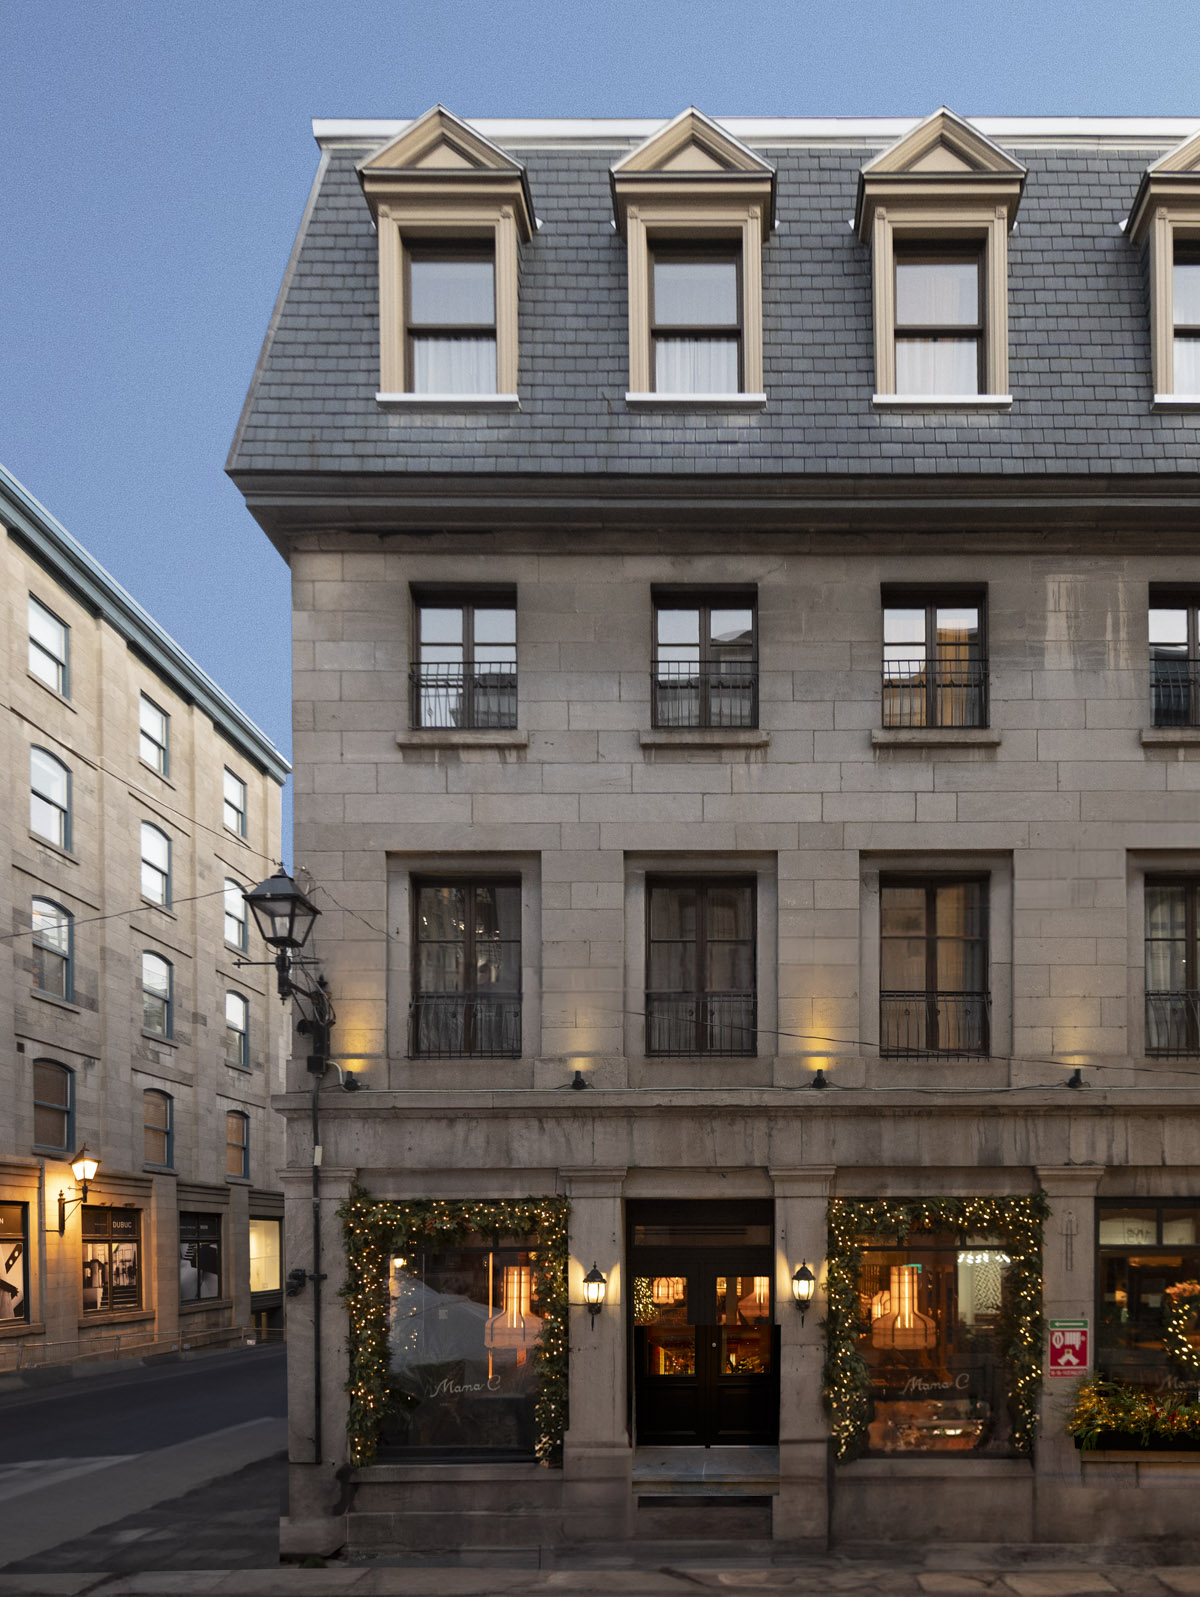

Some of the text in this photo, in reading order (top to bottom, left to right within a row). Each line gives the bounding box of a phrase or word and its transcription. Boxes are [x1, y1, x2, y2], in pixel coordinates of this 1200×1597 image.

[112, 1221, 132, 1229] DUBUC
[429, 1374, 501, 1398] Mama C
[897, 1372, 970, 1395] Mama C
